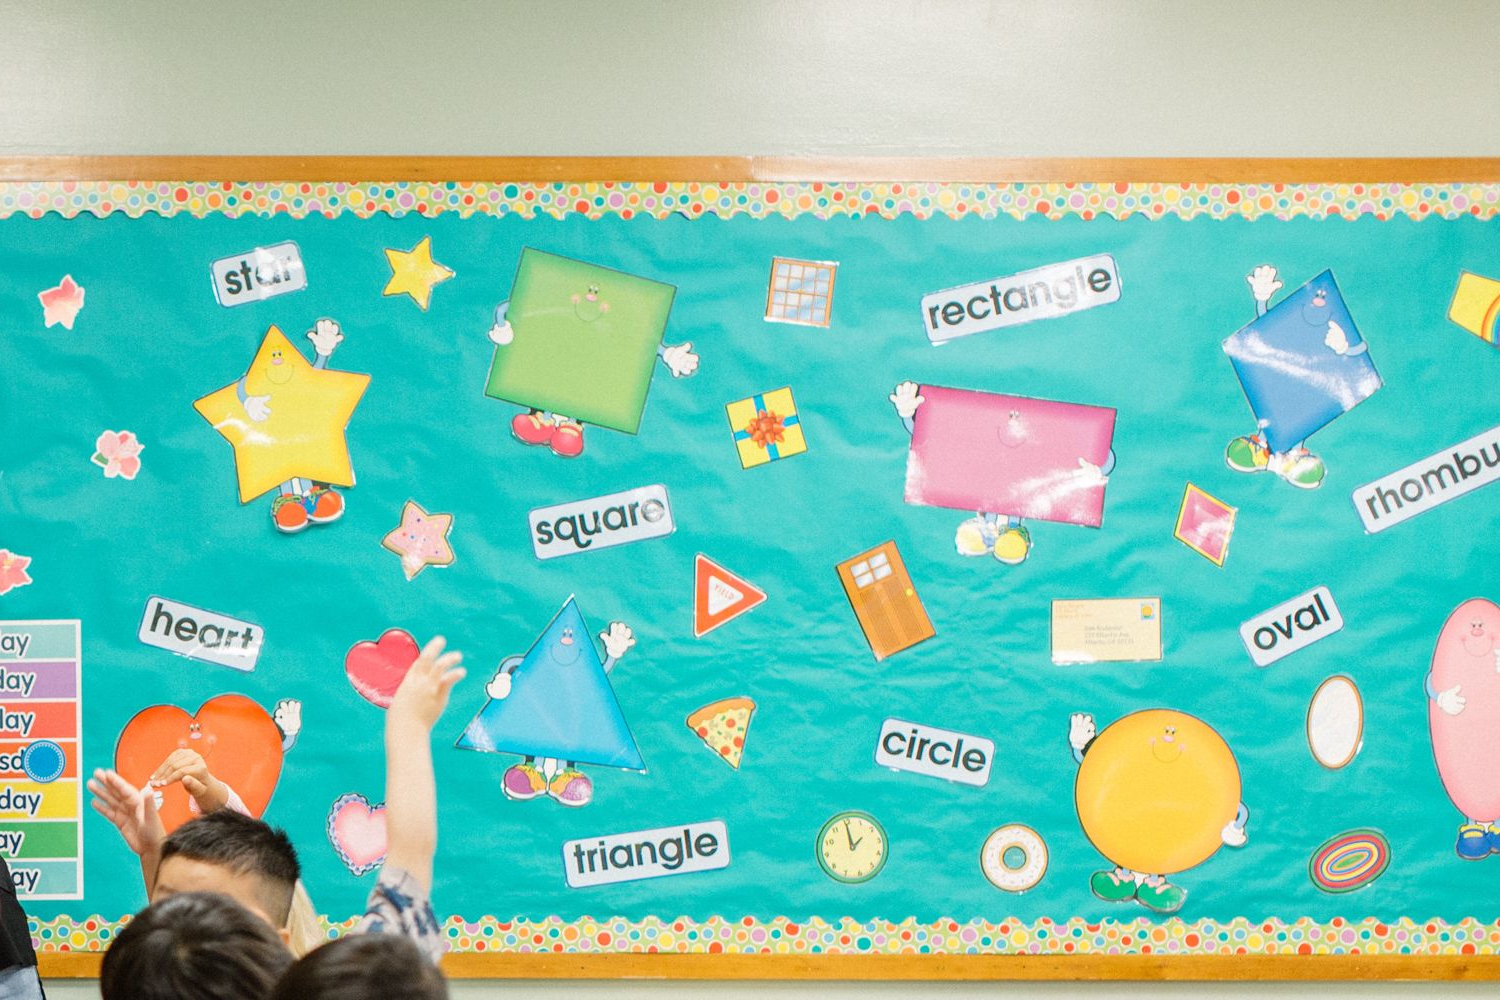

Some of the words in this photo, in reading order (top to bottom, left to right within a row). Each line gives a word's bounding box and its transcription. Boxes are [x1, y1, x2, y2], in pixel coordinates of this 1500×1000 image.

[928, 265, 1111, 329] rectangle
[1365, 442, 1500, 520] rhombu
[536, 499, 665, 548] square
[150, 602, 253, 648] heart
[1253, 593, 1330, 650] oval
[882, 729, 986, 772] circle
[574, 829, 718, 874] triangle
